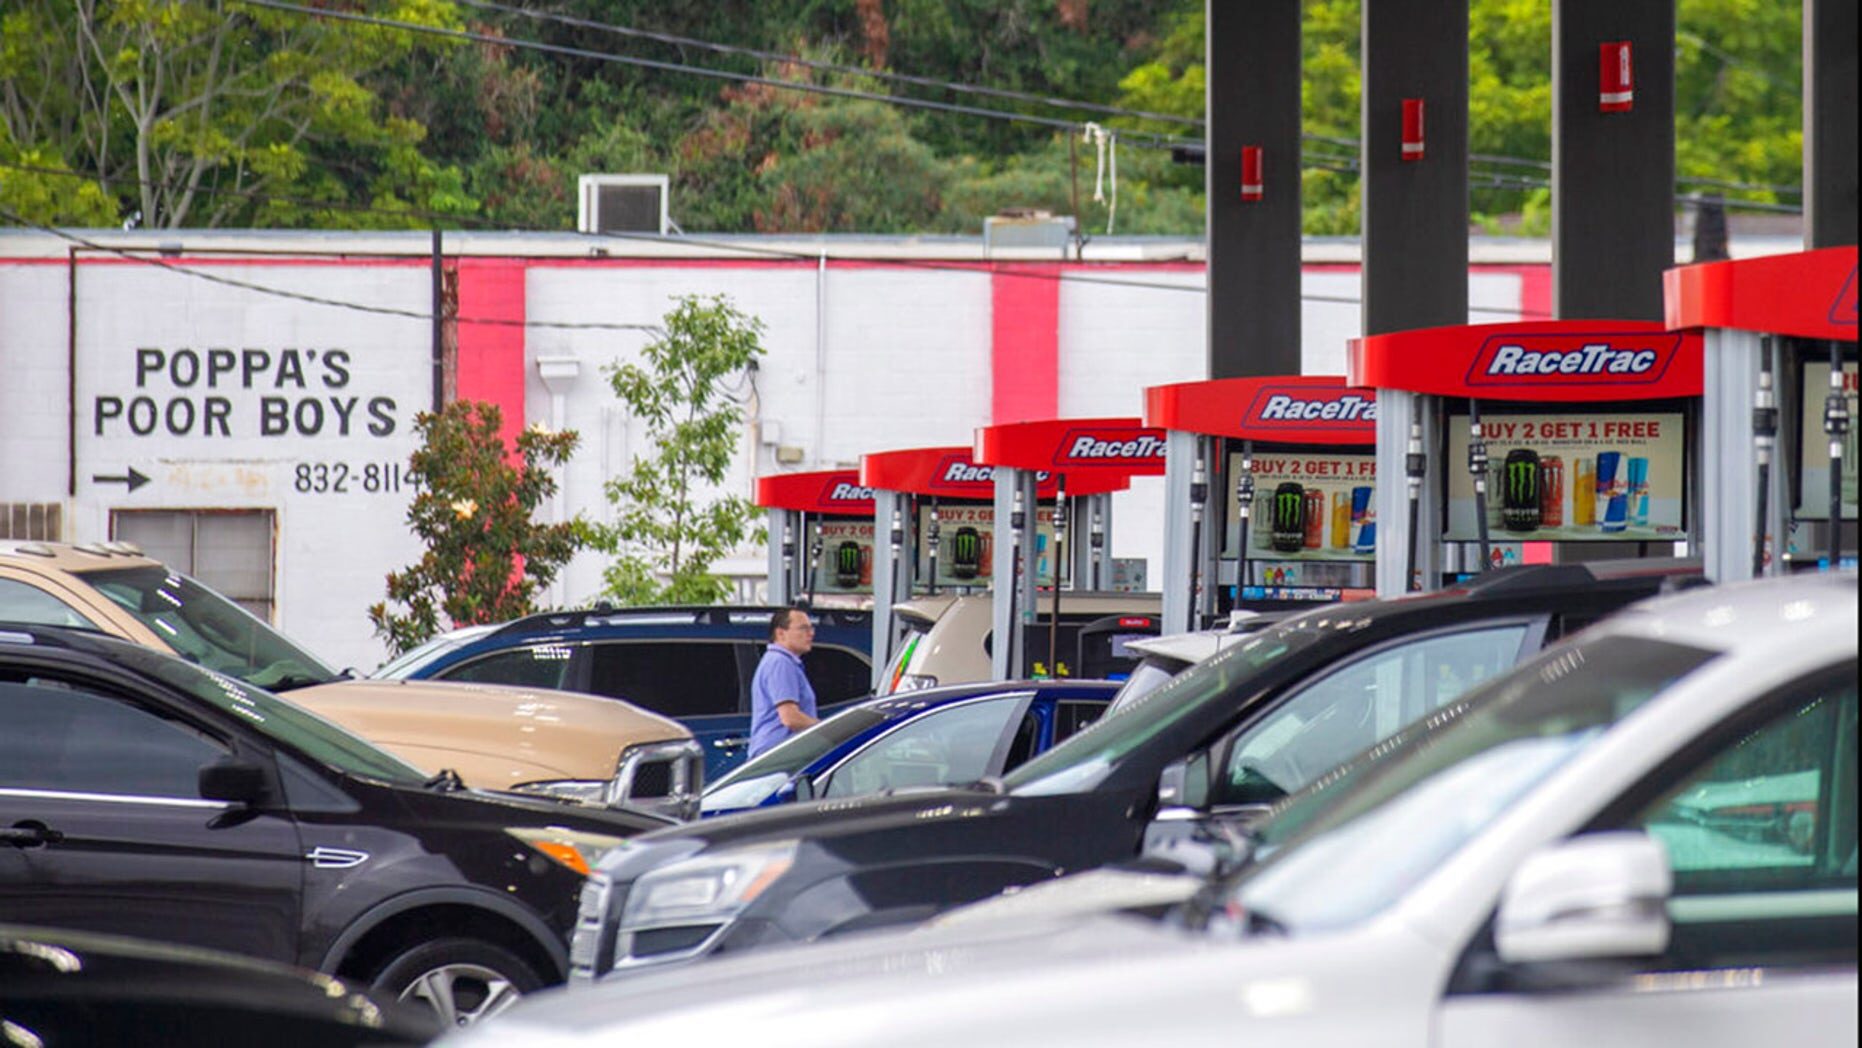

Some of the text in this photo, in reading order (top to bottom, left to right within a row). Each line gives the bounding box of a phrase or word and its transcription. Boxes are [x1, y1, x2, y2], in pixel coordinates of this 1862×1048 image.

[136, 348, 350, 388] POPPA'S
[1488, 345, 1656, 375] RaceTrac
[94, 396, 397, 437] POOR BOYS
[1260, 395, 1377, 420] RaceTra
[1523, 421, 1535, 438] 2
[1540, 421, 1582, 438] GET
[1588, 421, 1598, 438] 1
[1603, 421, 1661, 438] FREE
[1069, 436, 1168, 458] RaceTra
[294, 462, 424, 493] 832-8114
[1290, 460, 1301, 475] 2
[1304, 460, 1342, 476] GET
[1345, 461, 1354, 476] 1
